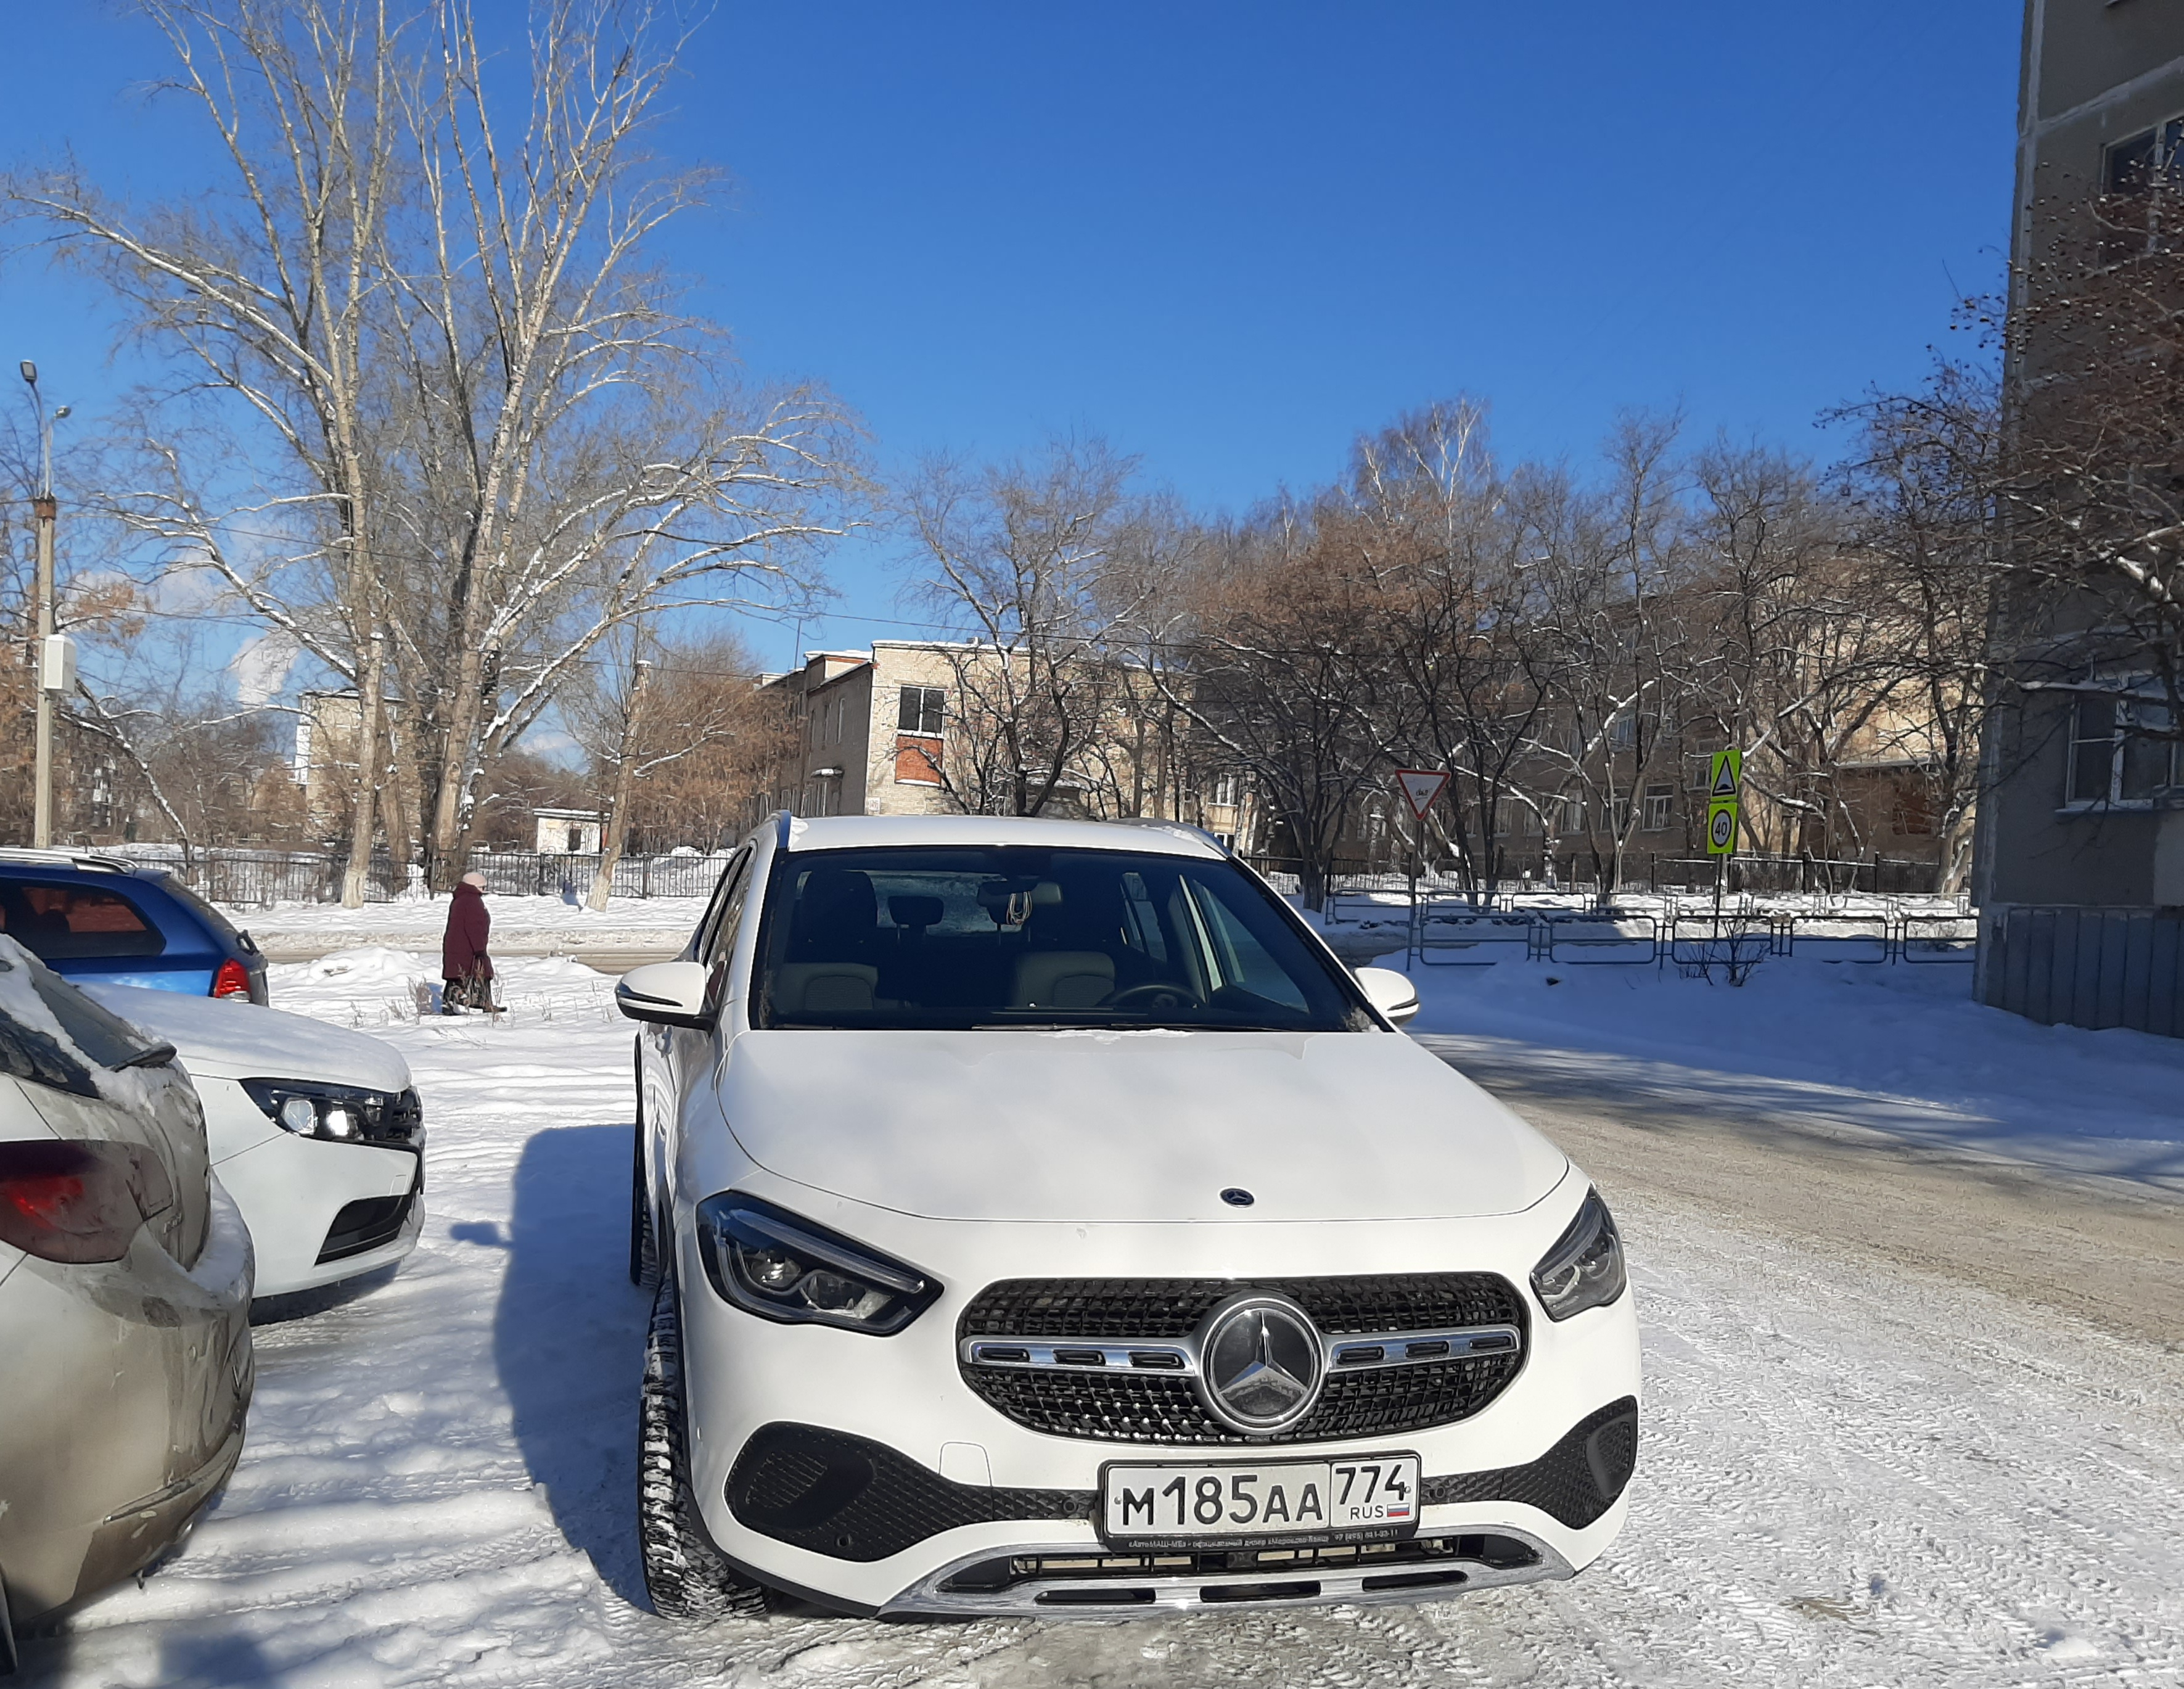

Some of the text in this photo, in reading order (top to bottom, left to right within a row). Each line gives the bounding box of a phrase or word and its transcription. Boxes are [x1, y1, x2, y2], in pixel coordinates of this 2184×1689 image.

[1715, 821, 1728, 836] 40
[1336, 1464, 1408, 1505] 774
[1350, 1505, 1384, 1520] RUS
